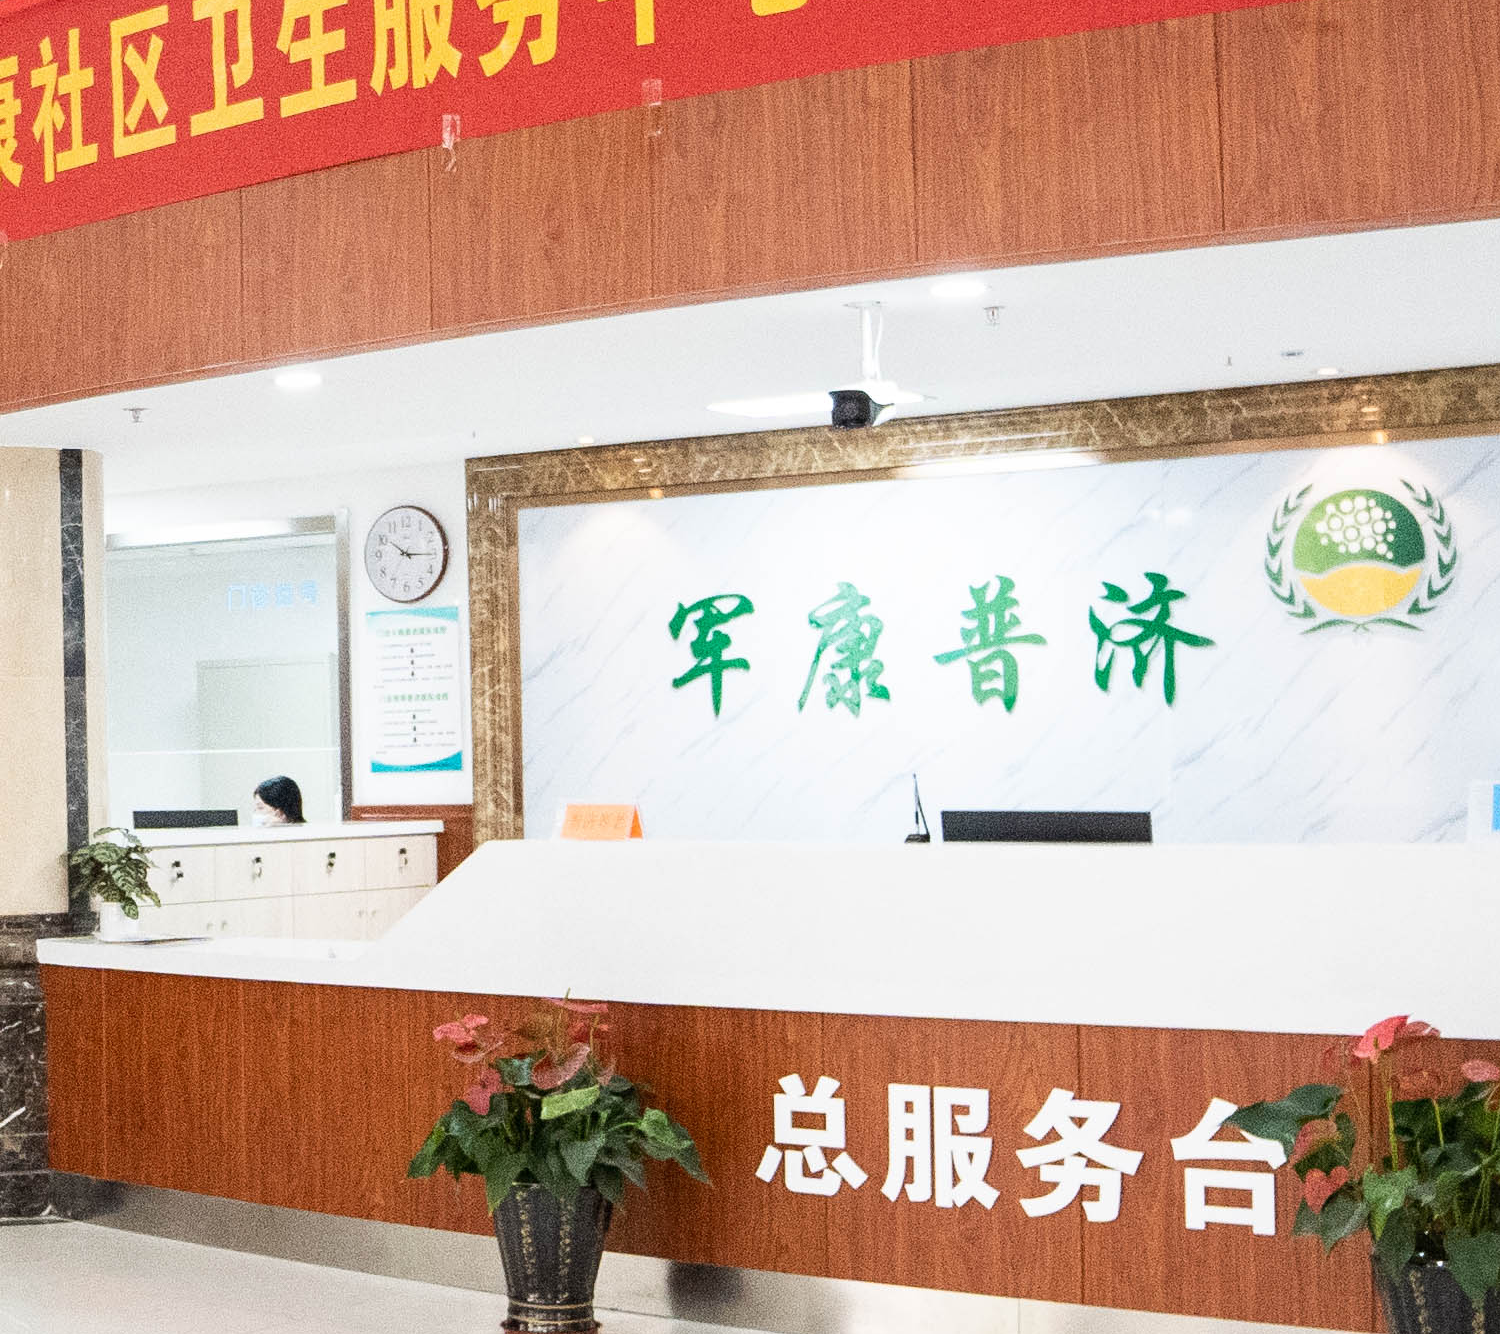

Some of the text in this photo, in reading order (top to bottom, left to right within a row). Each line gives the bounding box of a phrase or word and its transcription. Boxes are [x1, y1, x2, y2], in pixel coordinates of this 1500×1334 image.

[667, 572, 1216, 717] 军康普济
[755, 1073, 1287, 1236] 总服务台
